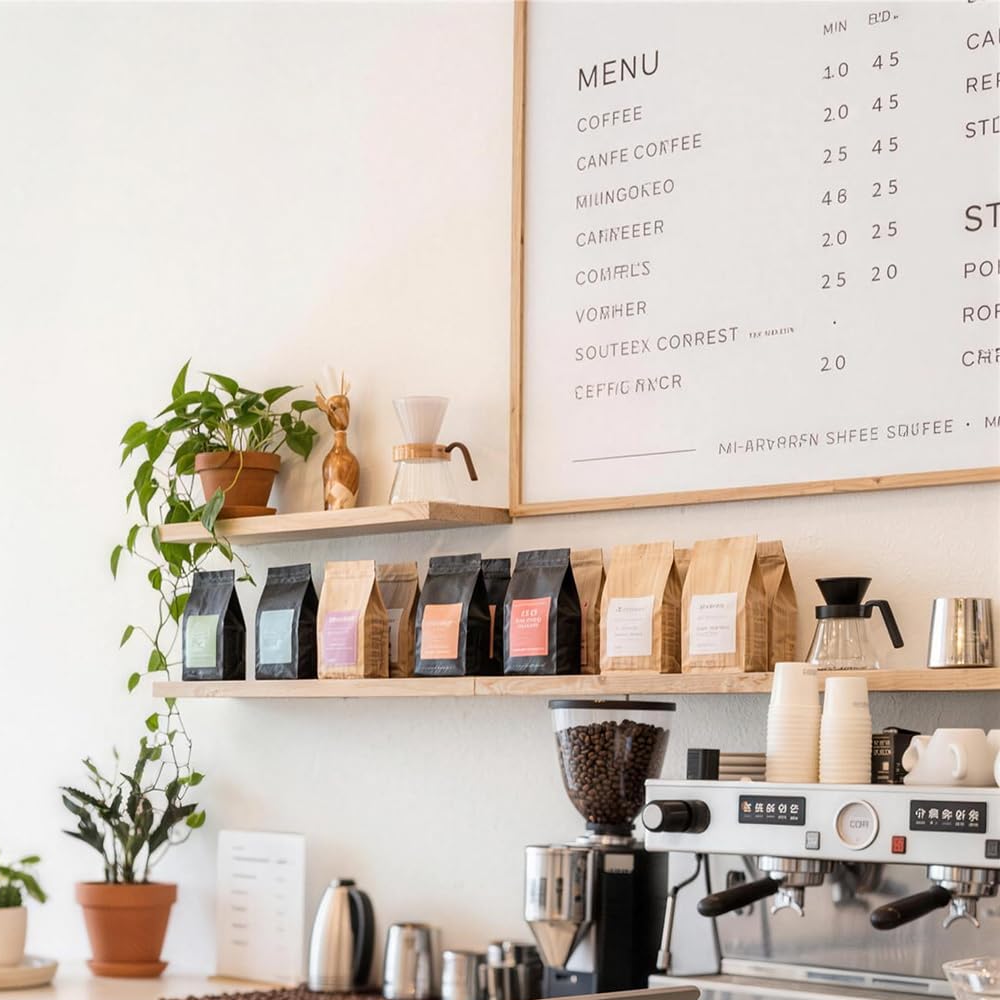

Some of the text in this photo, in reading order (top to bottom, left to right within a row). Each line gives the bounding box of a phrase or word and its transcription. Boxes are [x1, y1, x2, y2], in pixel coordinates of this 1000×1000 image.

[966, 27, 1000, 51] CA
[578, 49, 659, 92] MENU
[577, 105, 642, 133] COFFEE
[576, 147, 629, 172] CANFE
[963, 259, 1000, 280] PO
